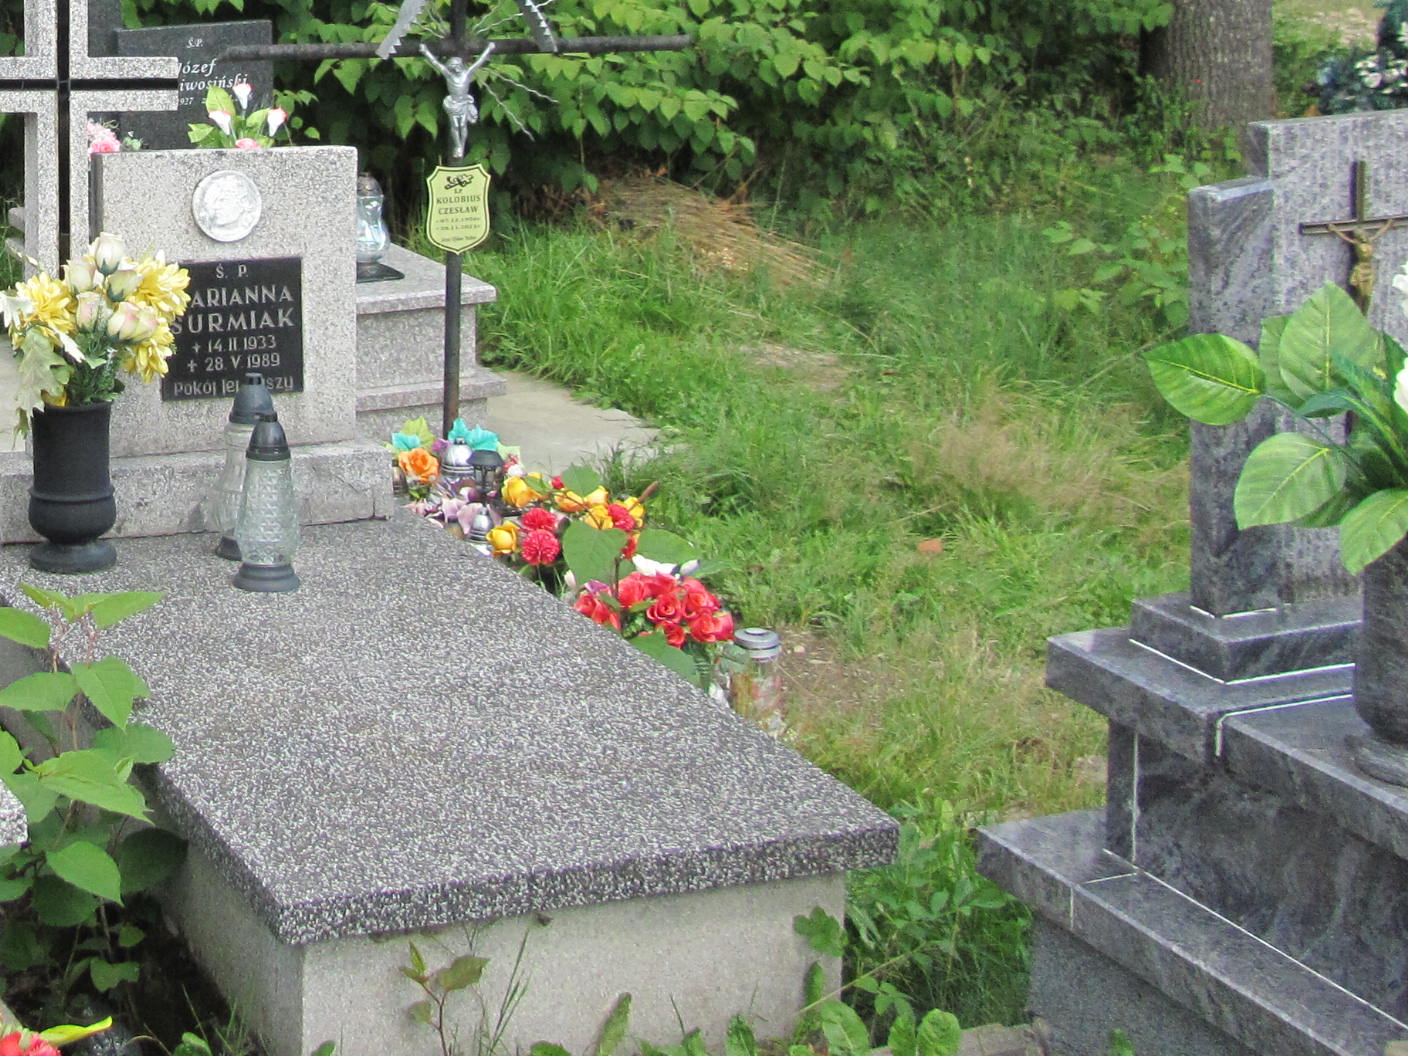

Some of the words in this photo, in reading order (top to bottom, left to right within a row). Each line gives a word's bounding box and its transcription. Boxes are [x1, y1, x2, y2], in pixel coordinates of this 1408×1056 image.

[179, 73, 248, 91] iwosiński
[179, 97, 193, 106] 927
[191, 285, 294, 308] ARIANNA
[247, 353, 280, 368] 1989
